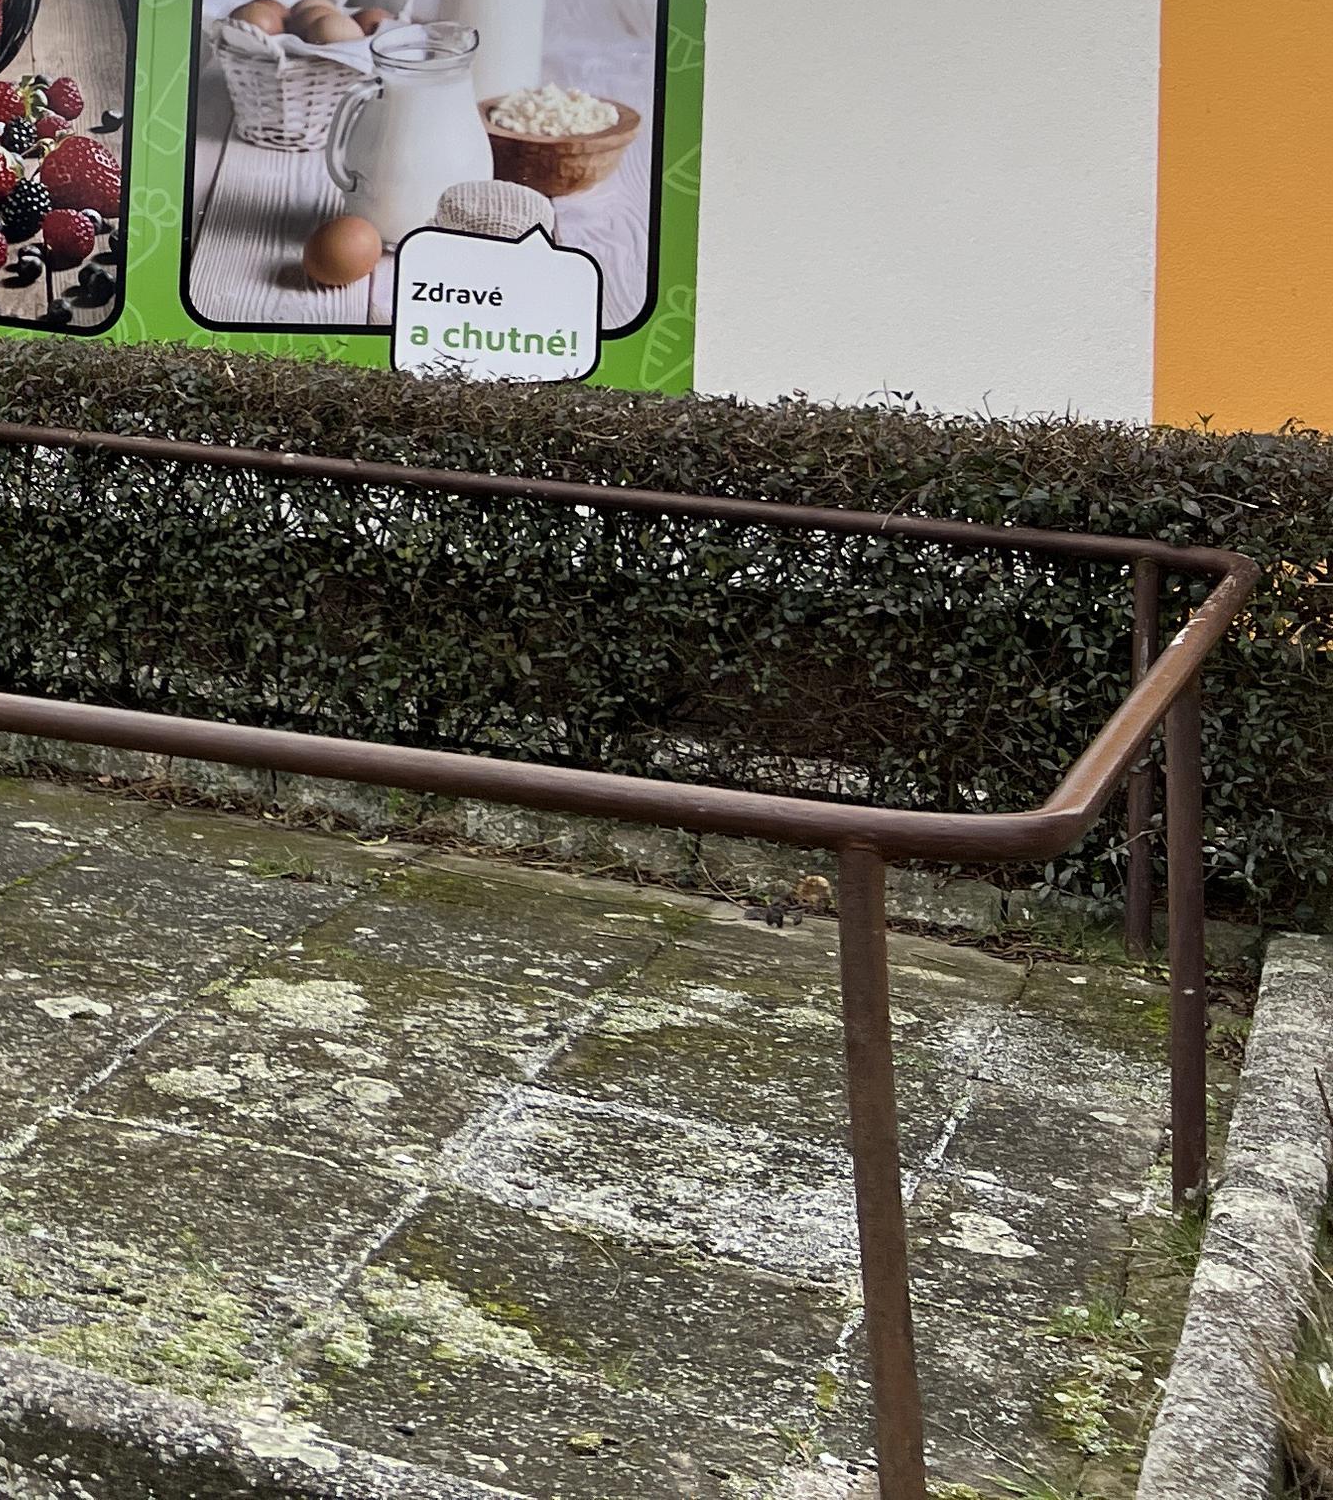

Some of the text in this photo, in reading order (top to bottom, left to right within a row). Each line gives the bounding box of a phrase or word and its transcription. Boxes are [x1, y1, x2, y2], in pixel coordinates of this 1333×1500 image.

[411, 281, 503, 307] Zdravé
[410, 321, 578, 357] a chutné!
